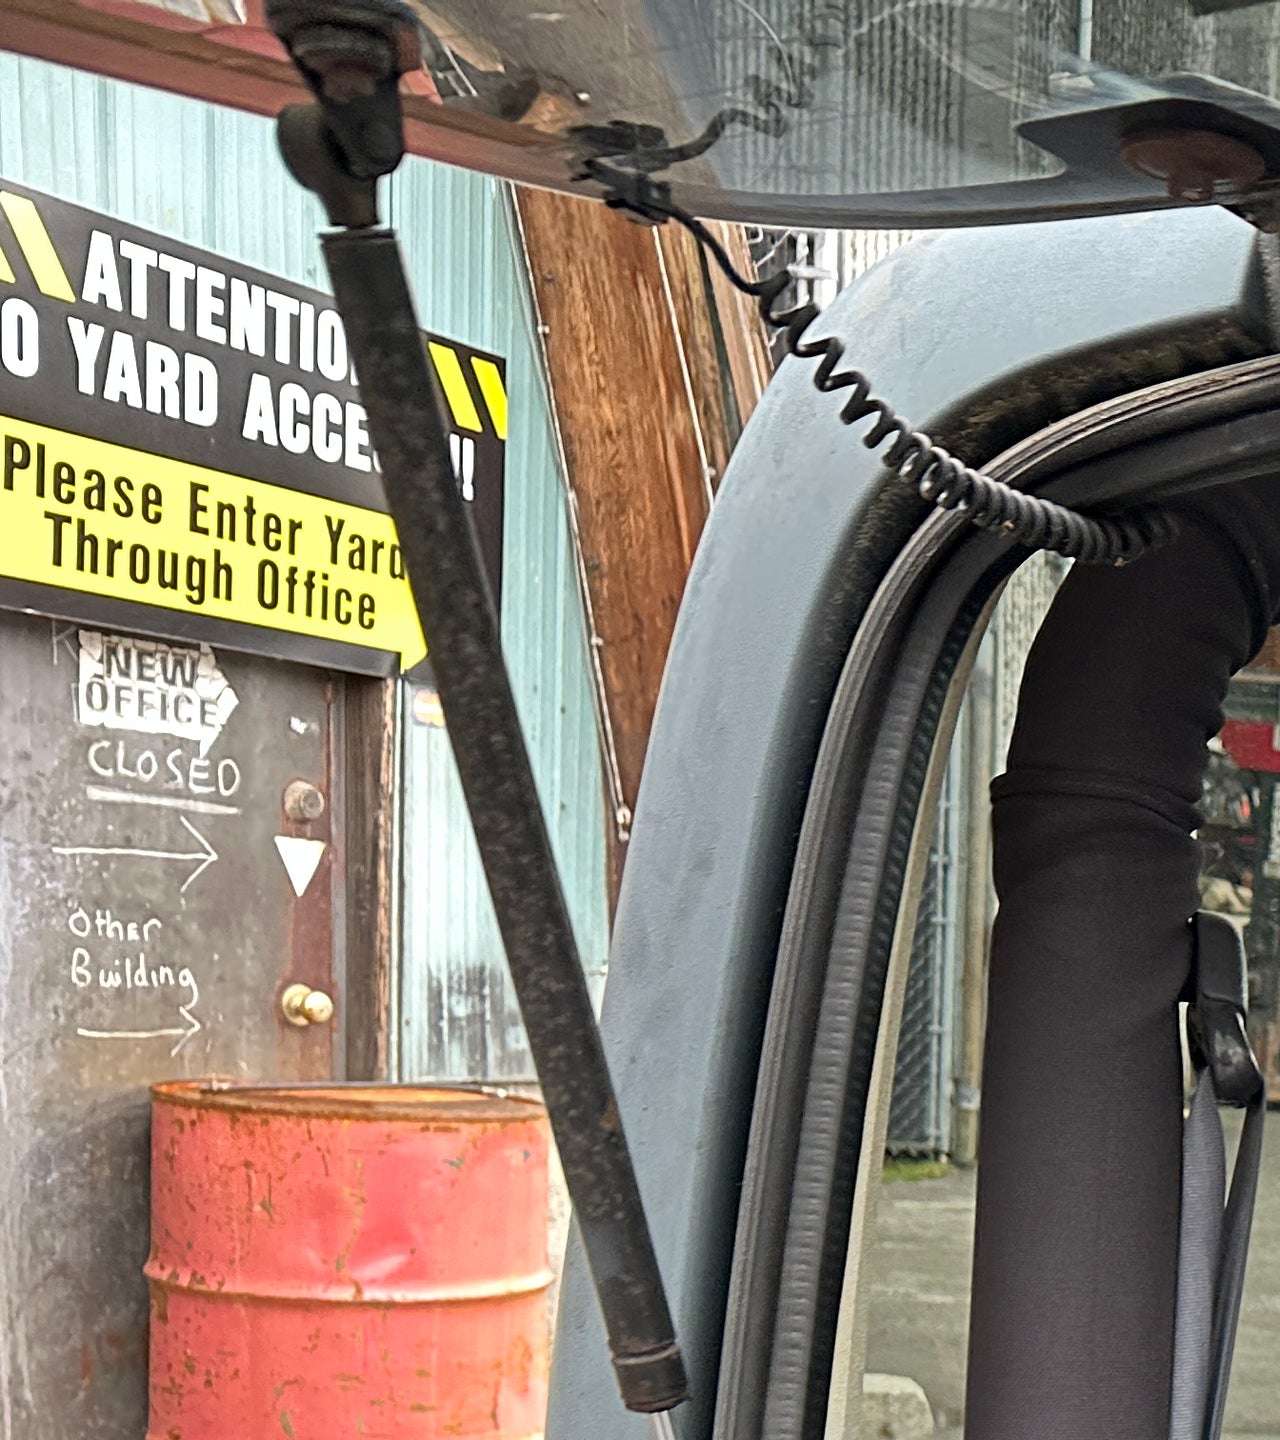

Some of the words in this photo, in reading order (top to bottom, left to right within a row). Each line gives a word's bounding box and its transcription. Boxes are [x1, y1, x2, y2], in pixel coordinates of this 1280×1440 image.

[81, 229, 359, 386] ATTENTIO
[67, 315, 219, 428] YARD
[242, 373, 476, 502] ACCE!!
[3, 434, 163, 525] Please
[188, 481, 302, 556] Enter
[324, 514, 405, 580] Yard
[44, 510, 233, 606] Through
[257, 558, 377, 631] Office
[85, 680, 220, 729] OFFICE
[102, 646, 197, 688] NEW
[87, 740, 241, 797] CLOSED
[70, 946, 200, 1012] Building
